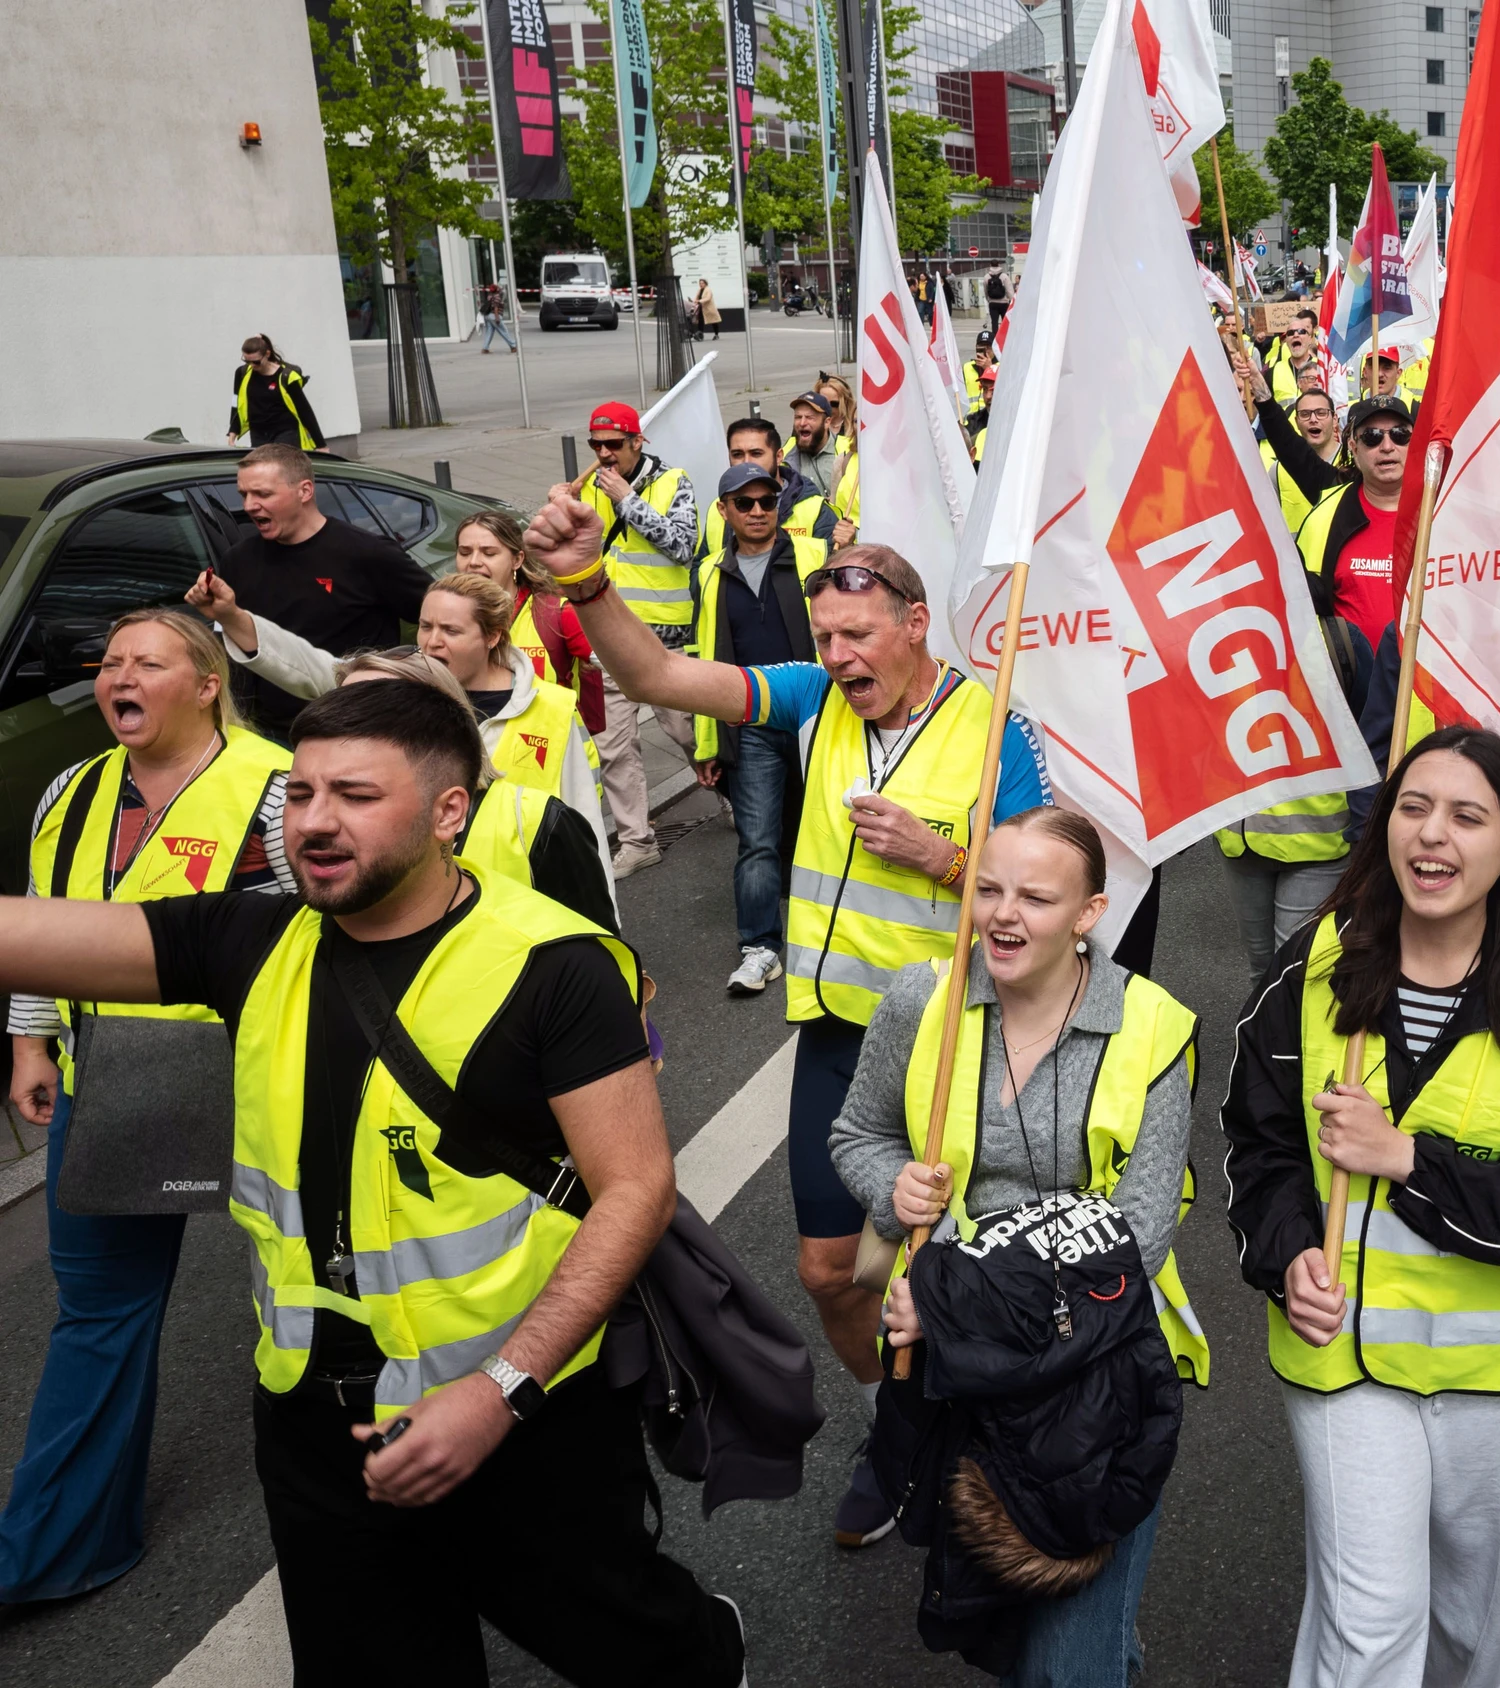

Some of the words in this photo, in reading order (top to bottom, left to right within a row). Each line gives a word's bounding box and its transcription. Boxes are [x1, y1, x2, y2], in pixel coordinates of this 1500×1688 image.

[744, 23, 754, 86] FORUM
[1135, 508, 1322, 778] NGG
[528, 736, 548, 748] NGG
[173, 839, 215, 858] NGG
[142, 857, 187, 891] GEWERKSCHAFT
[162, 1181, 193, 1191] DGB
